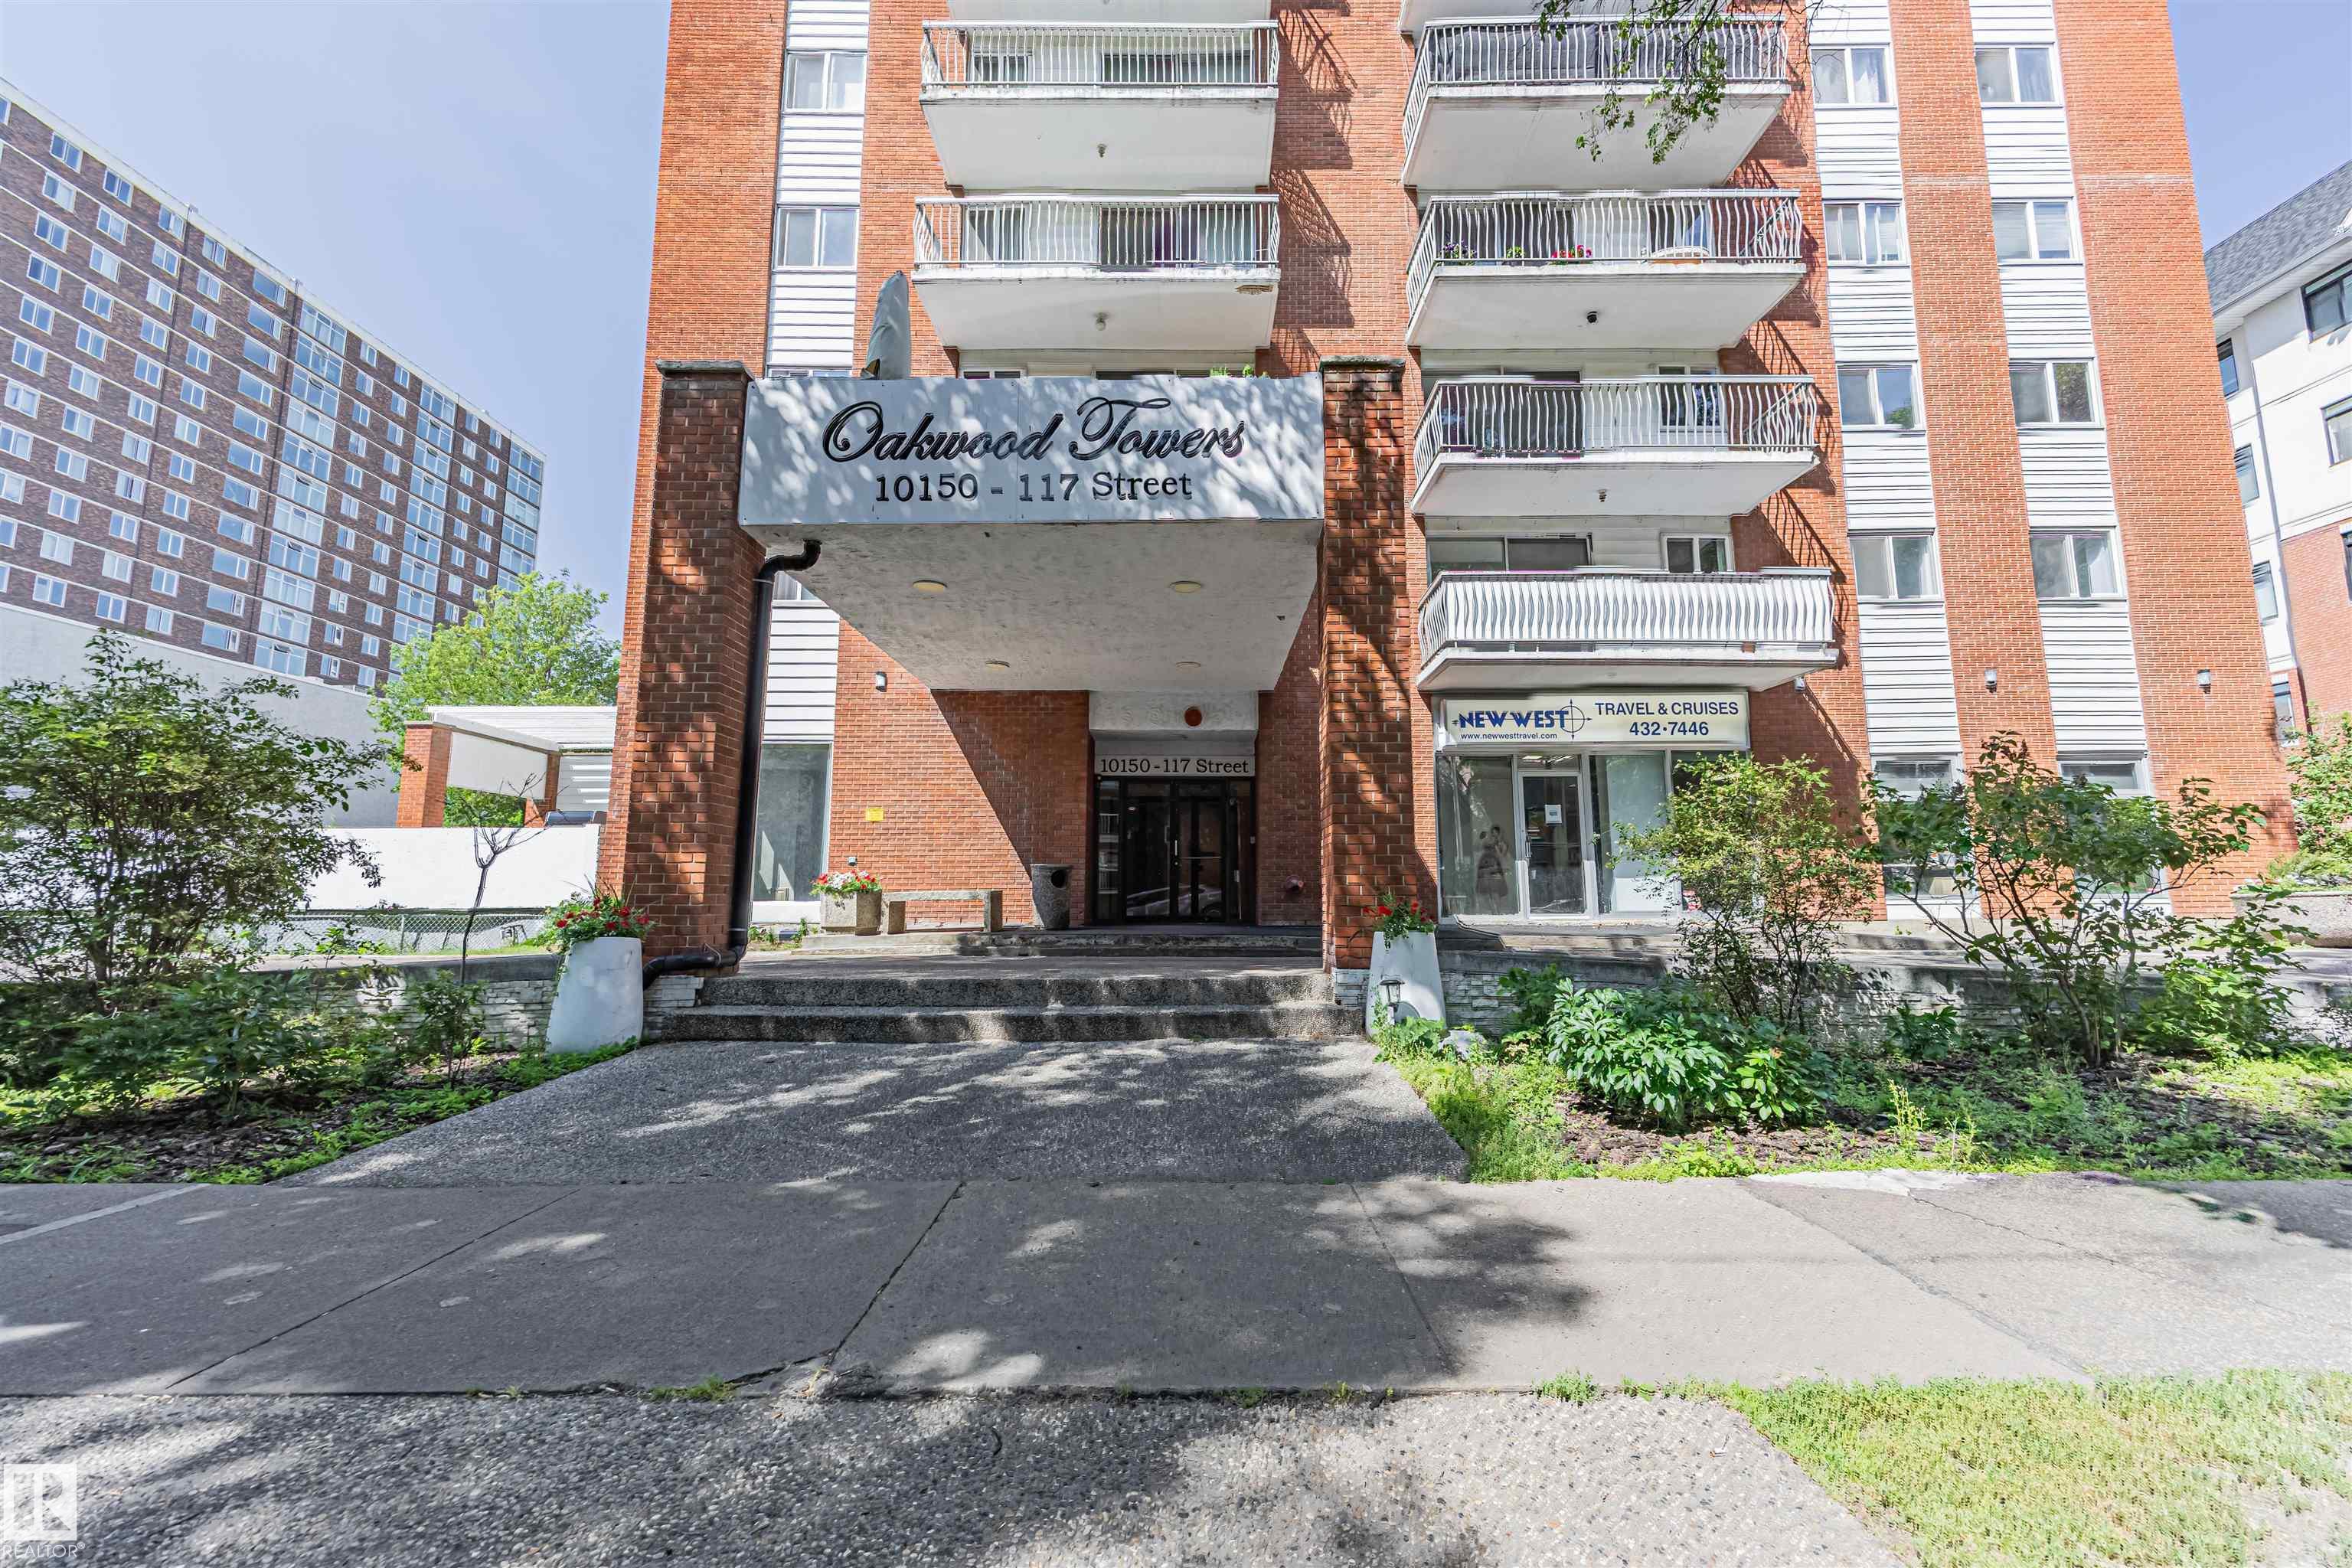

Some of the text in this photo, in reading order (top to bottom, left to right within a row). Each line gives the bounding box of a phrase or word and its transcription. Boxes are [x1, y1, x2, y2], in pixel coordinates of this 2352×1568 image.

[822, 396, 1246, 462] Oakwood Towers
[874, 472, 978, 502] 10150
[1018, 472, 1079, 501] 117
[1092, 470, 1193, 501] Street
[1595, 701, 1739, 716] TRAVEL & CRUISES
[1460, 732, 1557, 740] www.newwesttravel.com
[1099, 758, 1150, 773] 10150
[1163, 759, 1191, 773] 117
[1196, 758, 1250, 773] Street
